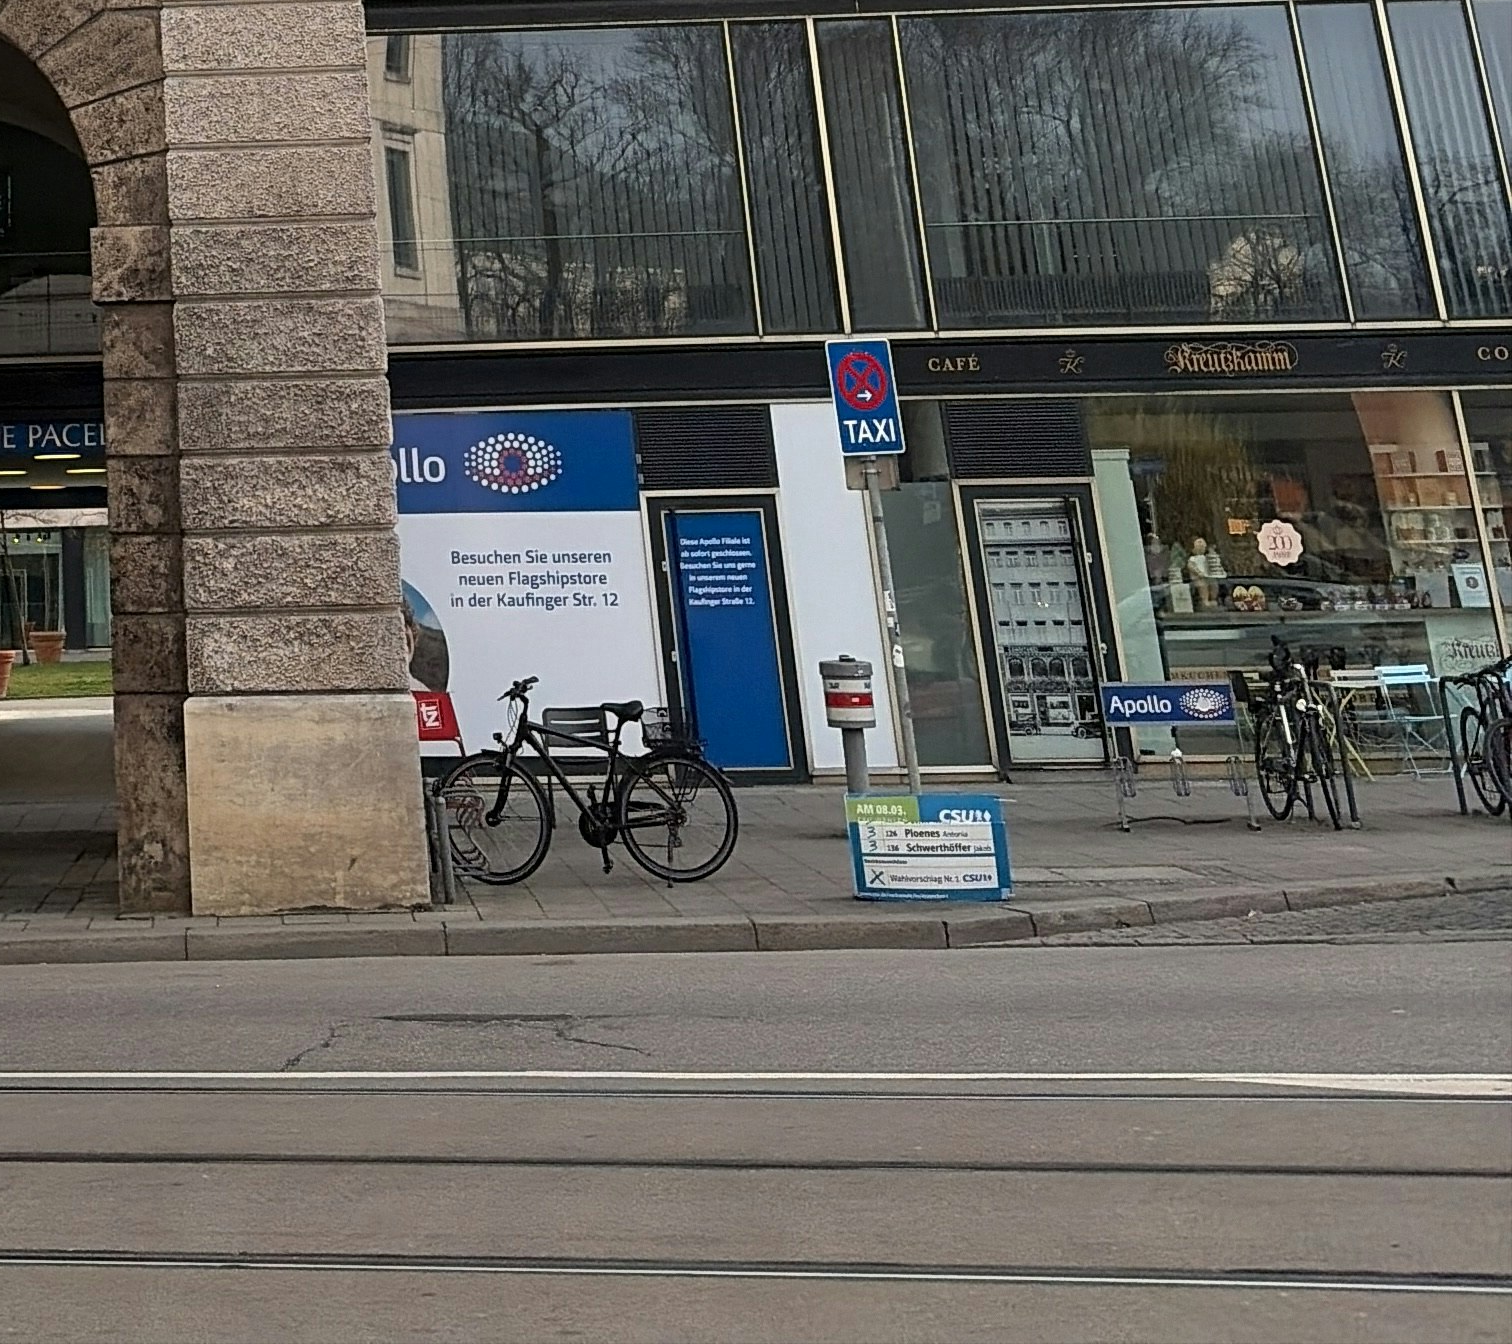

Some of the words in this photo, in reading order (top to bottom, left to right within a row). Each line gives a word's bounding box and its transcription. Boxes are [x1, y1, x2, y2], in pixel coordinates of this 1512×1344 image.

[928, 353, 980, 372] CAFÉ
[1164, 340, 1299, 377] Kreutzkamm
[843, 418, 897, 444] TAXI
[392, 447, 446, 483] llo
[680, 538, 699, 546] Diese
[699, 538, 721, 547] Apollo
[721, 537, 741, 545] Filiale
[741, 537, 751, 545] ist
[450, 550, 522, 565] Besuchen
[525, 549, 548, 564] Sie
[552, 551, 612, 564] unseren
[680, 550, 690, 558] ab
[690, 549, 711, 558] sofort
[680, 562, 711, 570] Besuchen
[712, 561, 723, 569] Sie
[737, 562, 757, 571] gerne
[458, 574, 504, 586] neuen
[508, 570, 608, 590] Flagshipstore
[689, 574, 696, 582] in
[688, 585, 732, 596] Flagshipstore
[733, 585, 741, 593] in
[740, 585, 753, 593] der
[450, 593, 464, 608] in
[468, 593, 493, 608] der
[497, 592, 569, 611] Kaufinger
[573, 592, 597, 607] Str.
[602, 593, 619, 607] 12
[689, 598, 721, 607] Kaufinger
[721, 597, 744, 606] Straße
[744, 597, 756, 605] 12.
[1109, 694, 1172, 718] Apollo
[420, 702, 440, 728] tz
[856, 804, 874, 815] AM
[875, 804, 907, 816] 08.03.
[939, 809, 973, 823] CSU
[904, 828, 941, 839] Ploenes
[906, 843, 971, 853] Schwerthöffer
[890, 873, 943, 885] Wahlvorschlag
[962, 873, 983, 883] CSU
